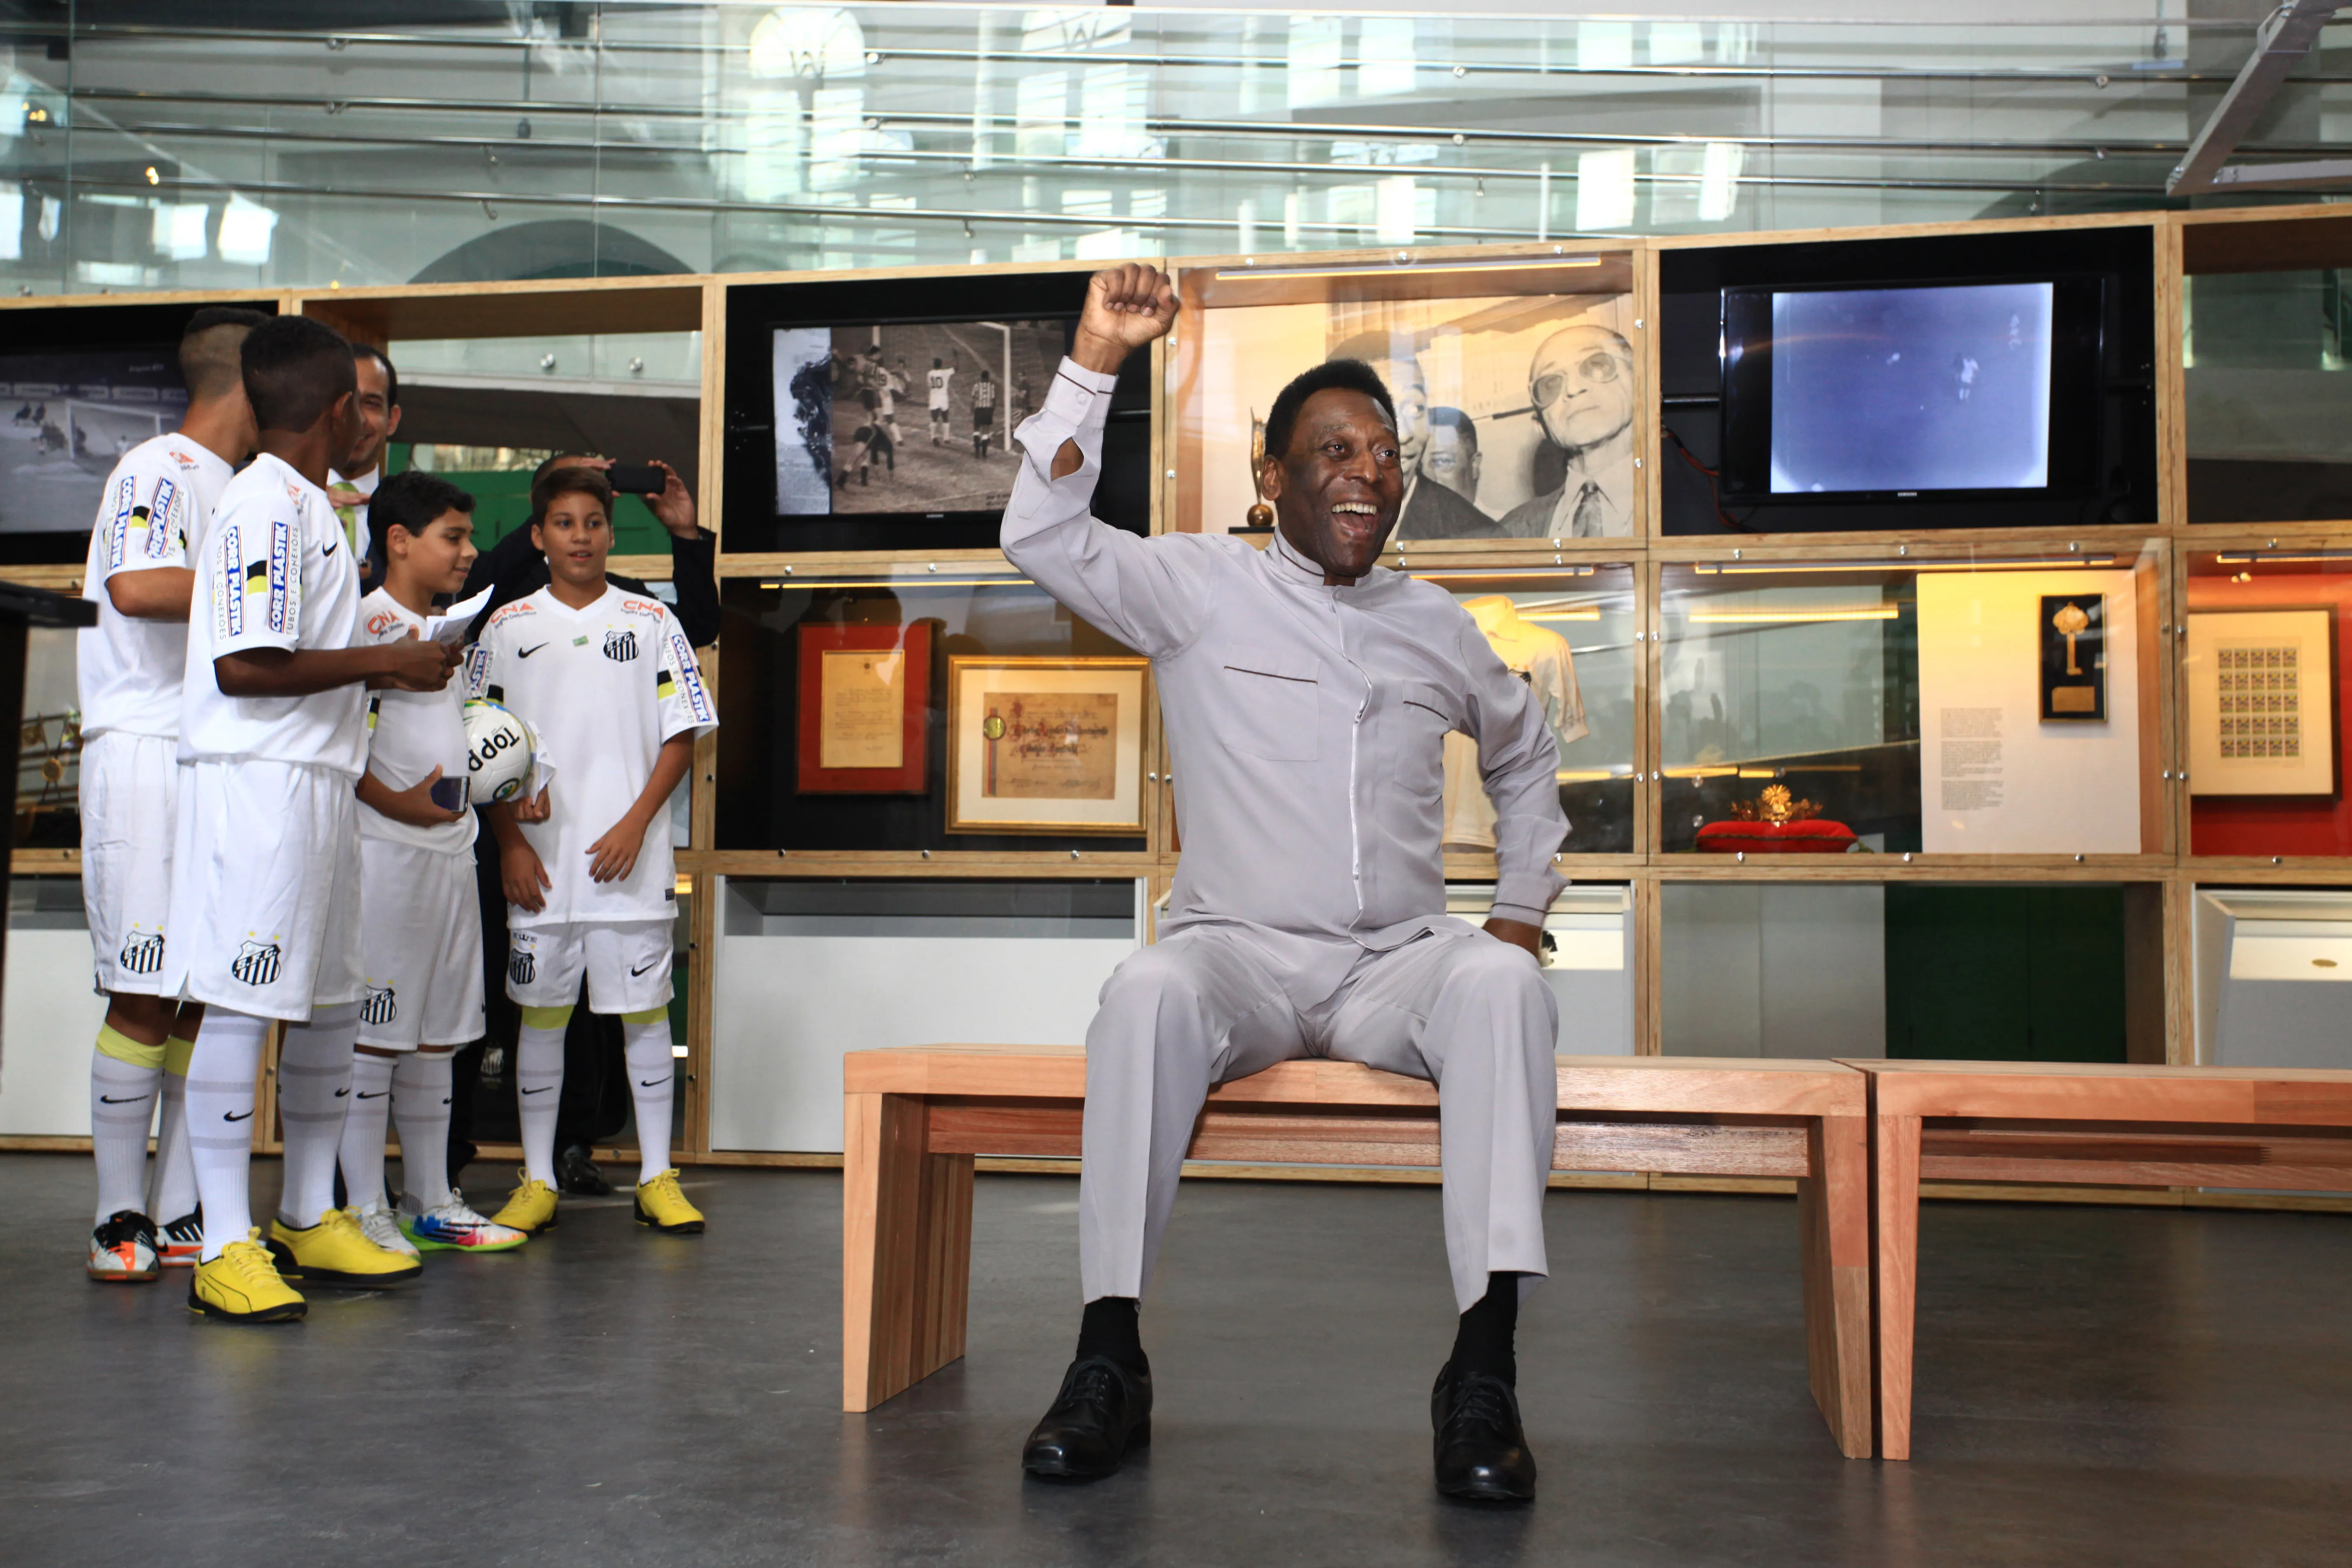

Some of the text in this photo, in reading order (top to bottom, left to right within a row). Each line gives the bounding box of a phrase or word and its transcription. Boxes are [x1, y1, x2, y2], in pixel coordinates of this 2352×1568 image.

[931, 377, 943, 389] 10
[289, 526, 299, 583] CONEXÕES
[227, 527, 242, 636] CORR PLASTIK
[271, 523, 288, 632] CORR PLASTIK
[286, 601, 297, 635] TUBOS
[490, 602, 535, 624] CNA
[623, 600, 664, 620] CNA
[673, 634, 710, 722] CORR PLASTIK
